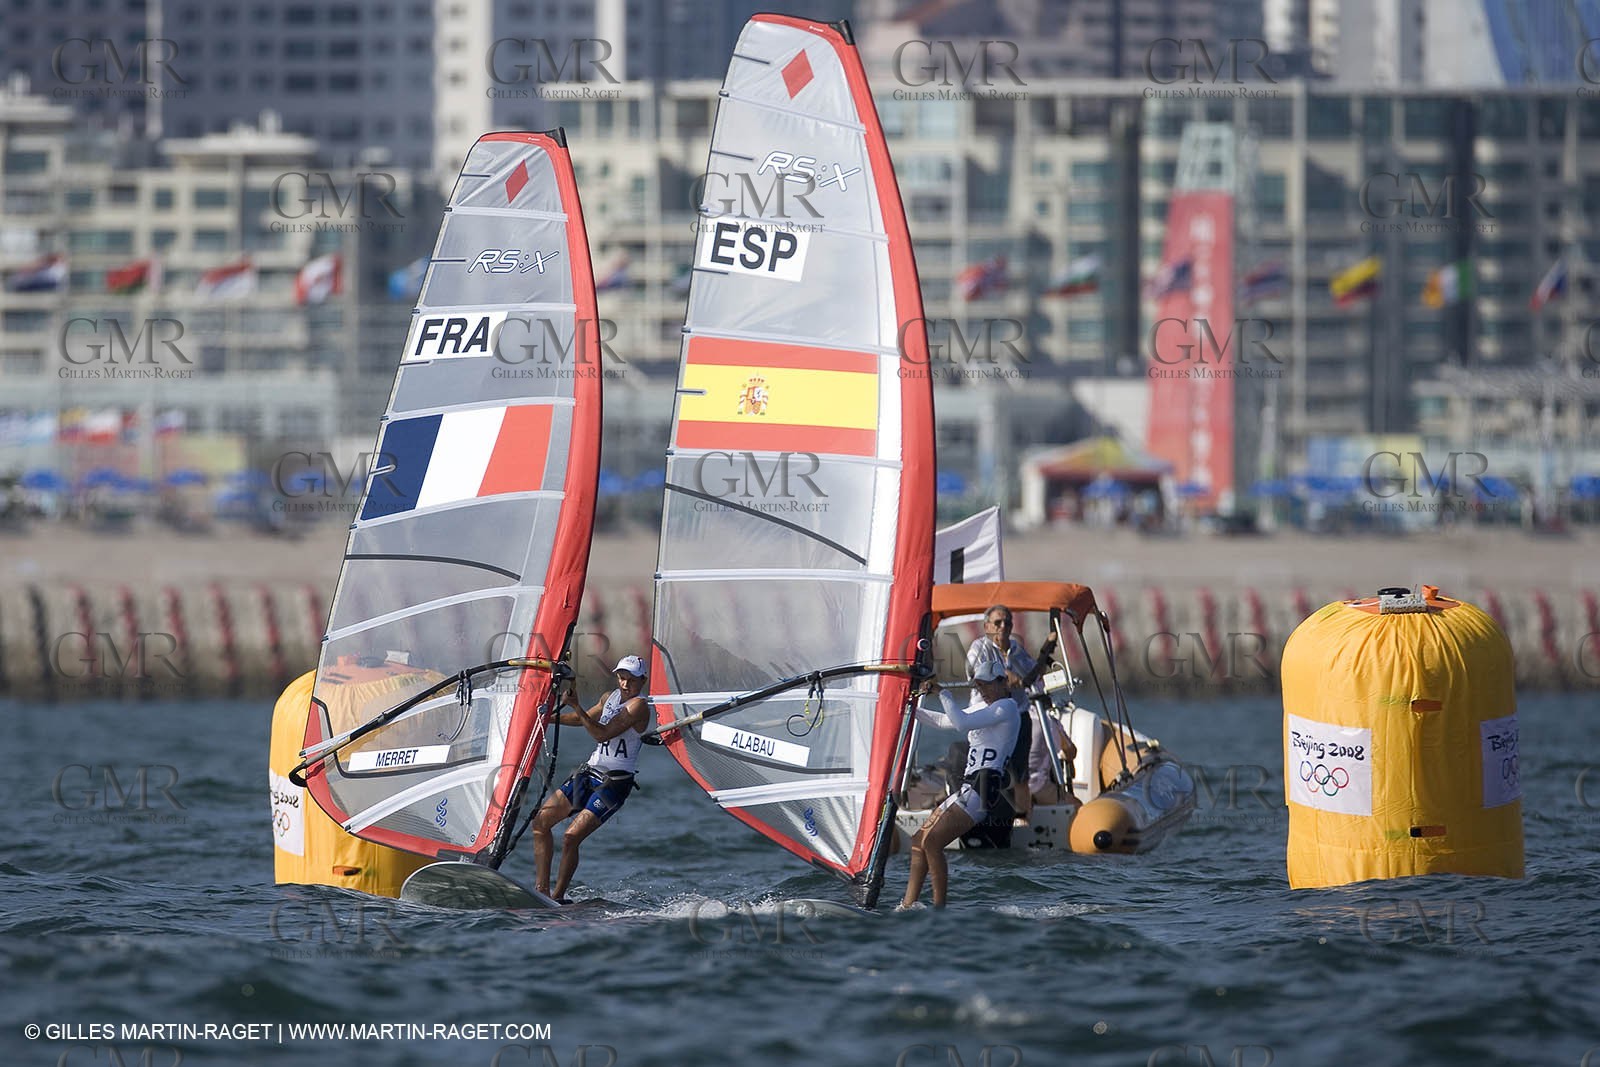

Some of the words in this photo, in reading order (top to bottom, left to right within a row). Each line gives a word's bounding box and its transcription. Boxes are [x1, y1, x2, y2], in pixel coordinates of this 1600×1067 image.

[710, 222, 798, 272] ESP
[467, 249, 560, 274] RS:X
[414, 316, 490, 356] FRA
[600, 739, 628, 758] RA
[731, 732, 775, 756] ALABAU
[1291, 731, 1325, 759] Beijing
[1328, 743, 1364, 761] 2008
[375, 749, 419, 767] MERRET
[968, 748, 997, 767] SP
